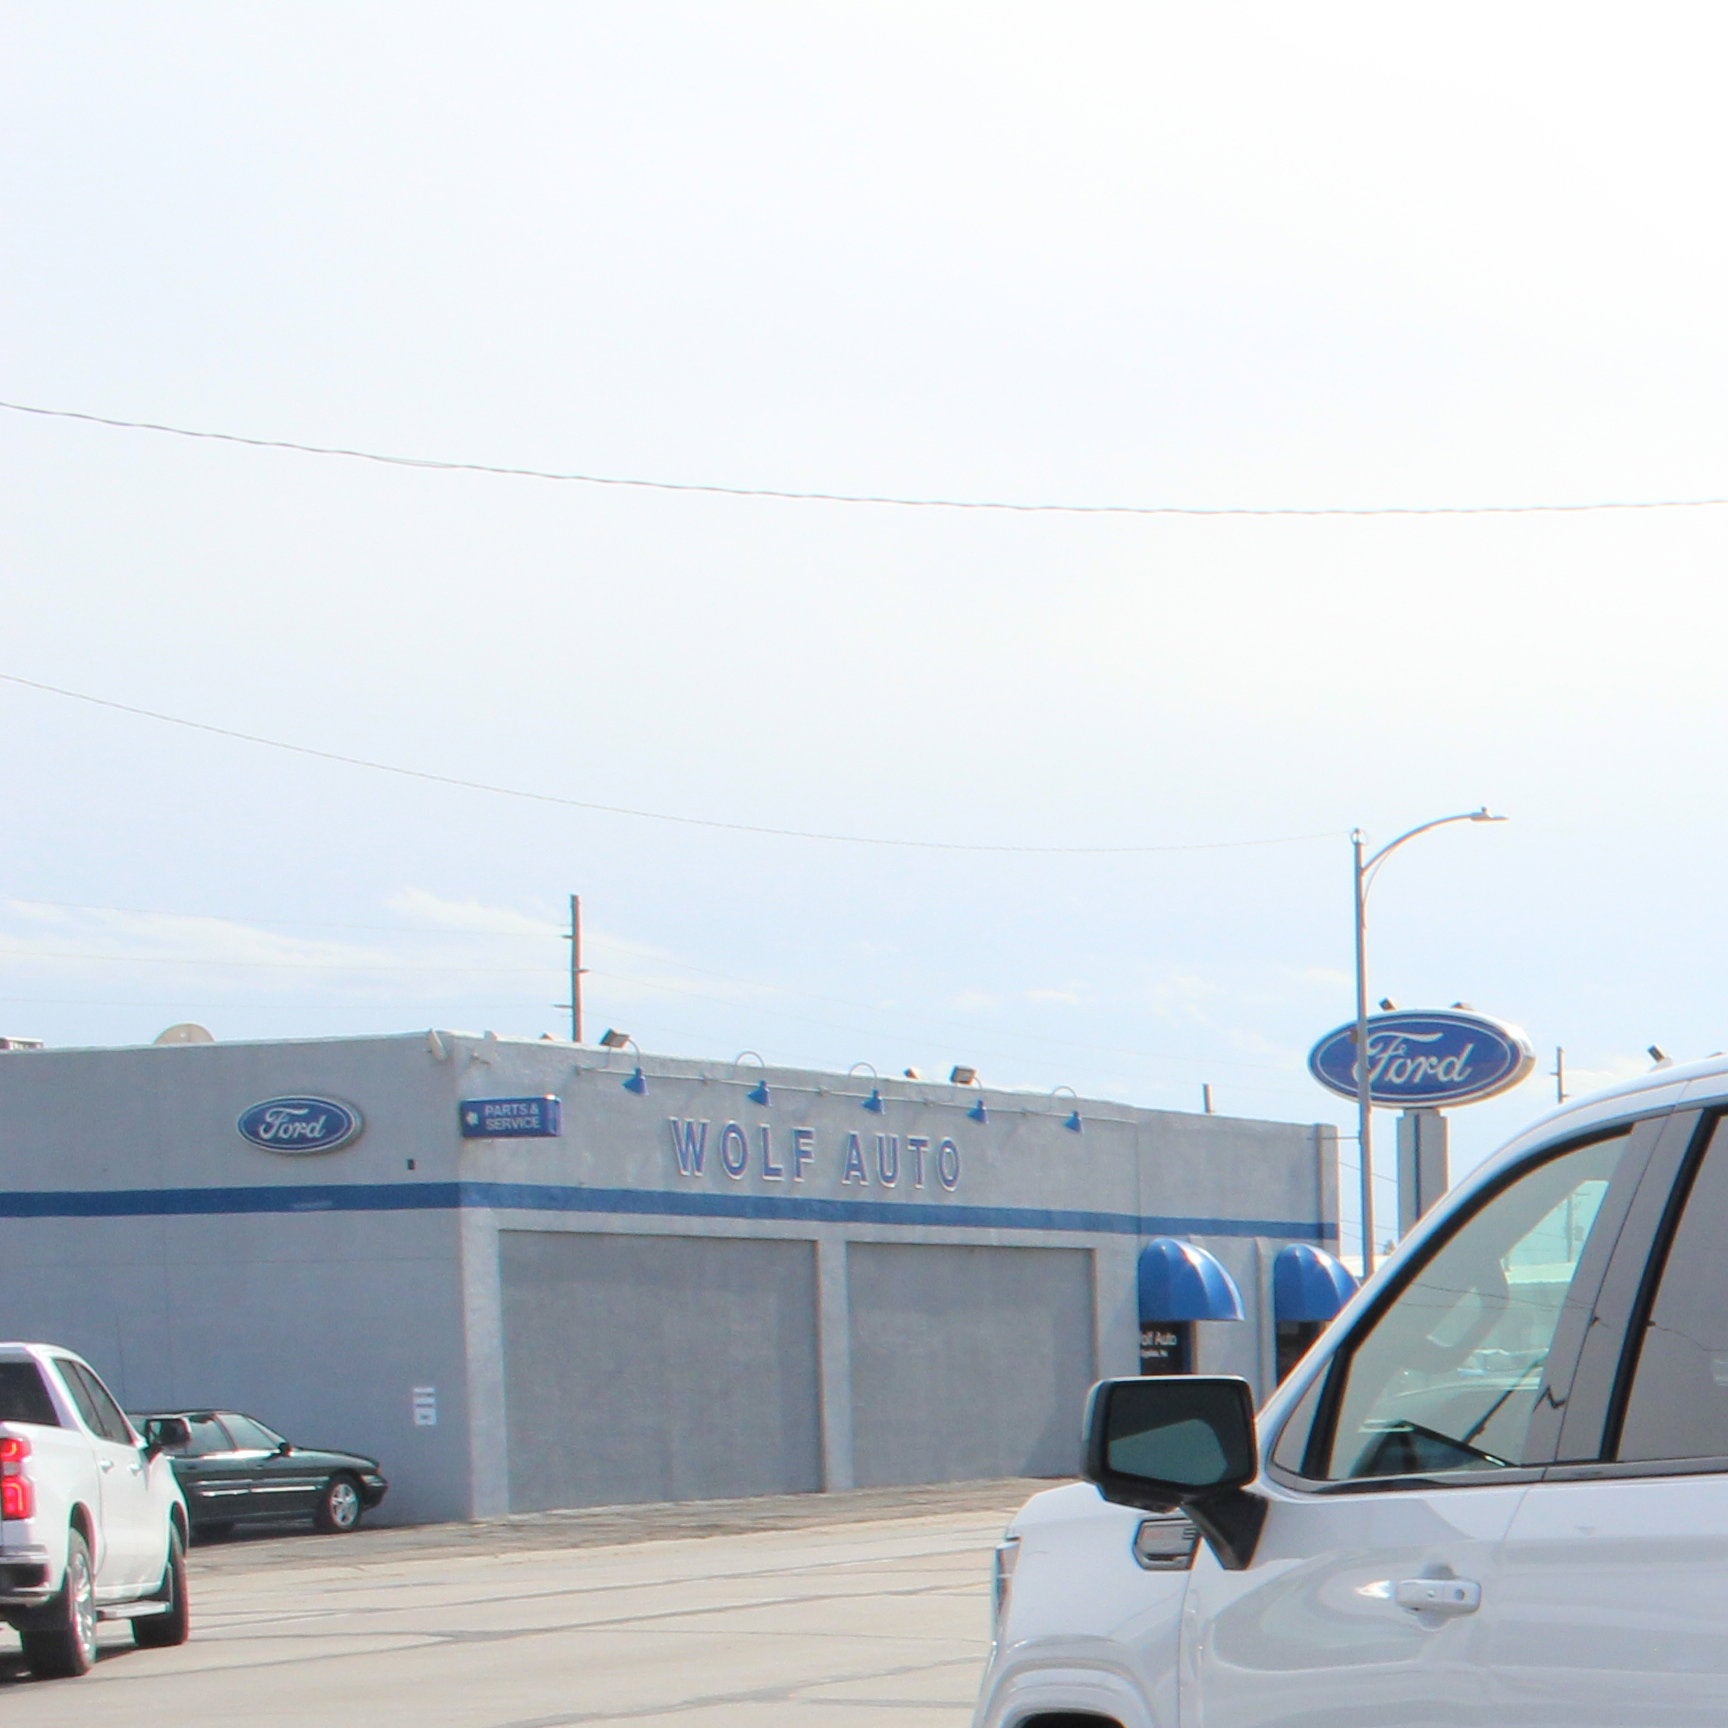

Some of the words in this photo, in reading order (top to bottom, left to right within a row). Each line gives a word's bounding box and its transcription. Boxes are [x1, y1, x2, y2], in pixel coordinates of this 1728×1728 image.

[1352, 1031, 1474, 1085] Ford
[484, 1103, 528, 1117] PARTS
[529, 1102, 540, 1115] &
[259, 1107, 327, 1140] Ford
[485, 1116, 540, 1131] SERVICE
[668, 1116, 816, 1184] WOLF
[841, 1130, 962, 1192] AUTO
[1154, 1331, 1177, 1346] Auto
